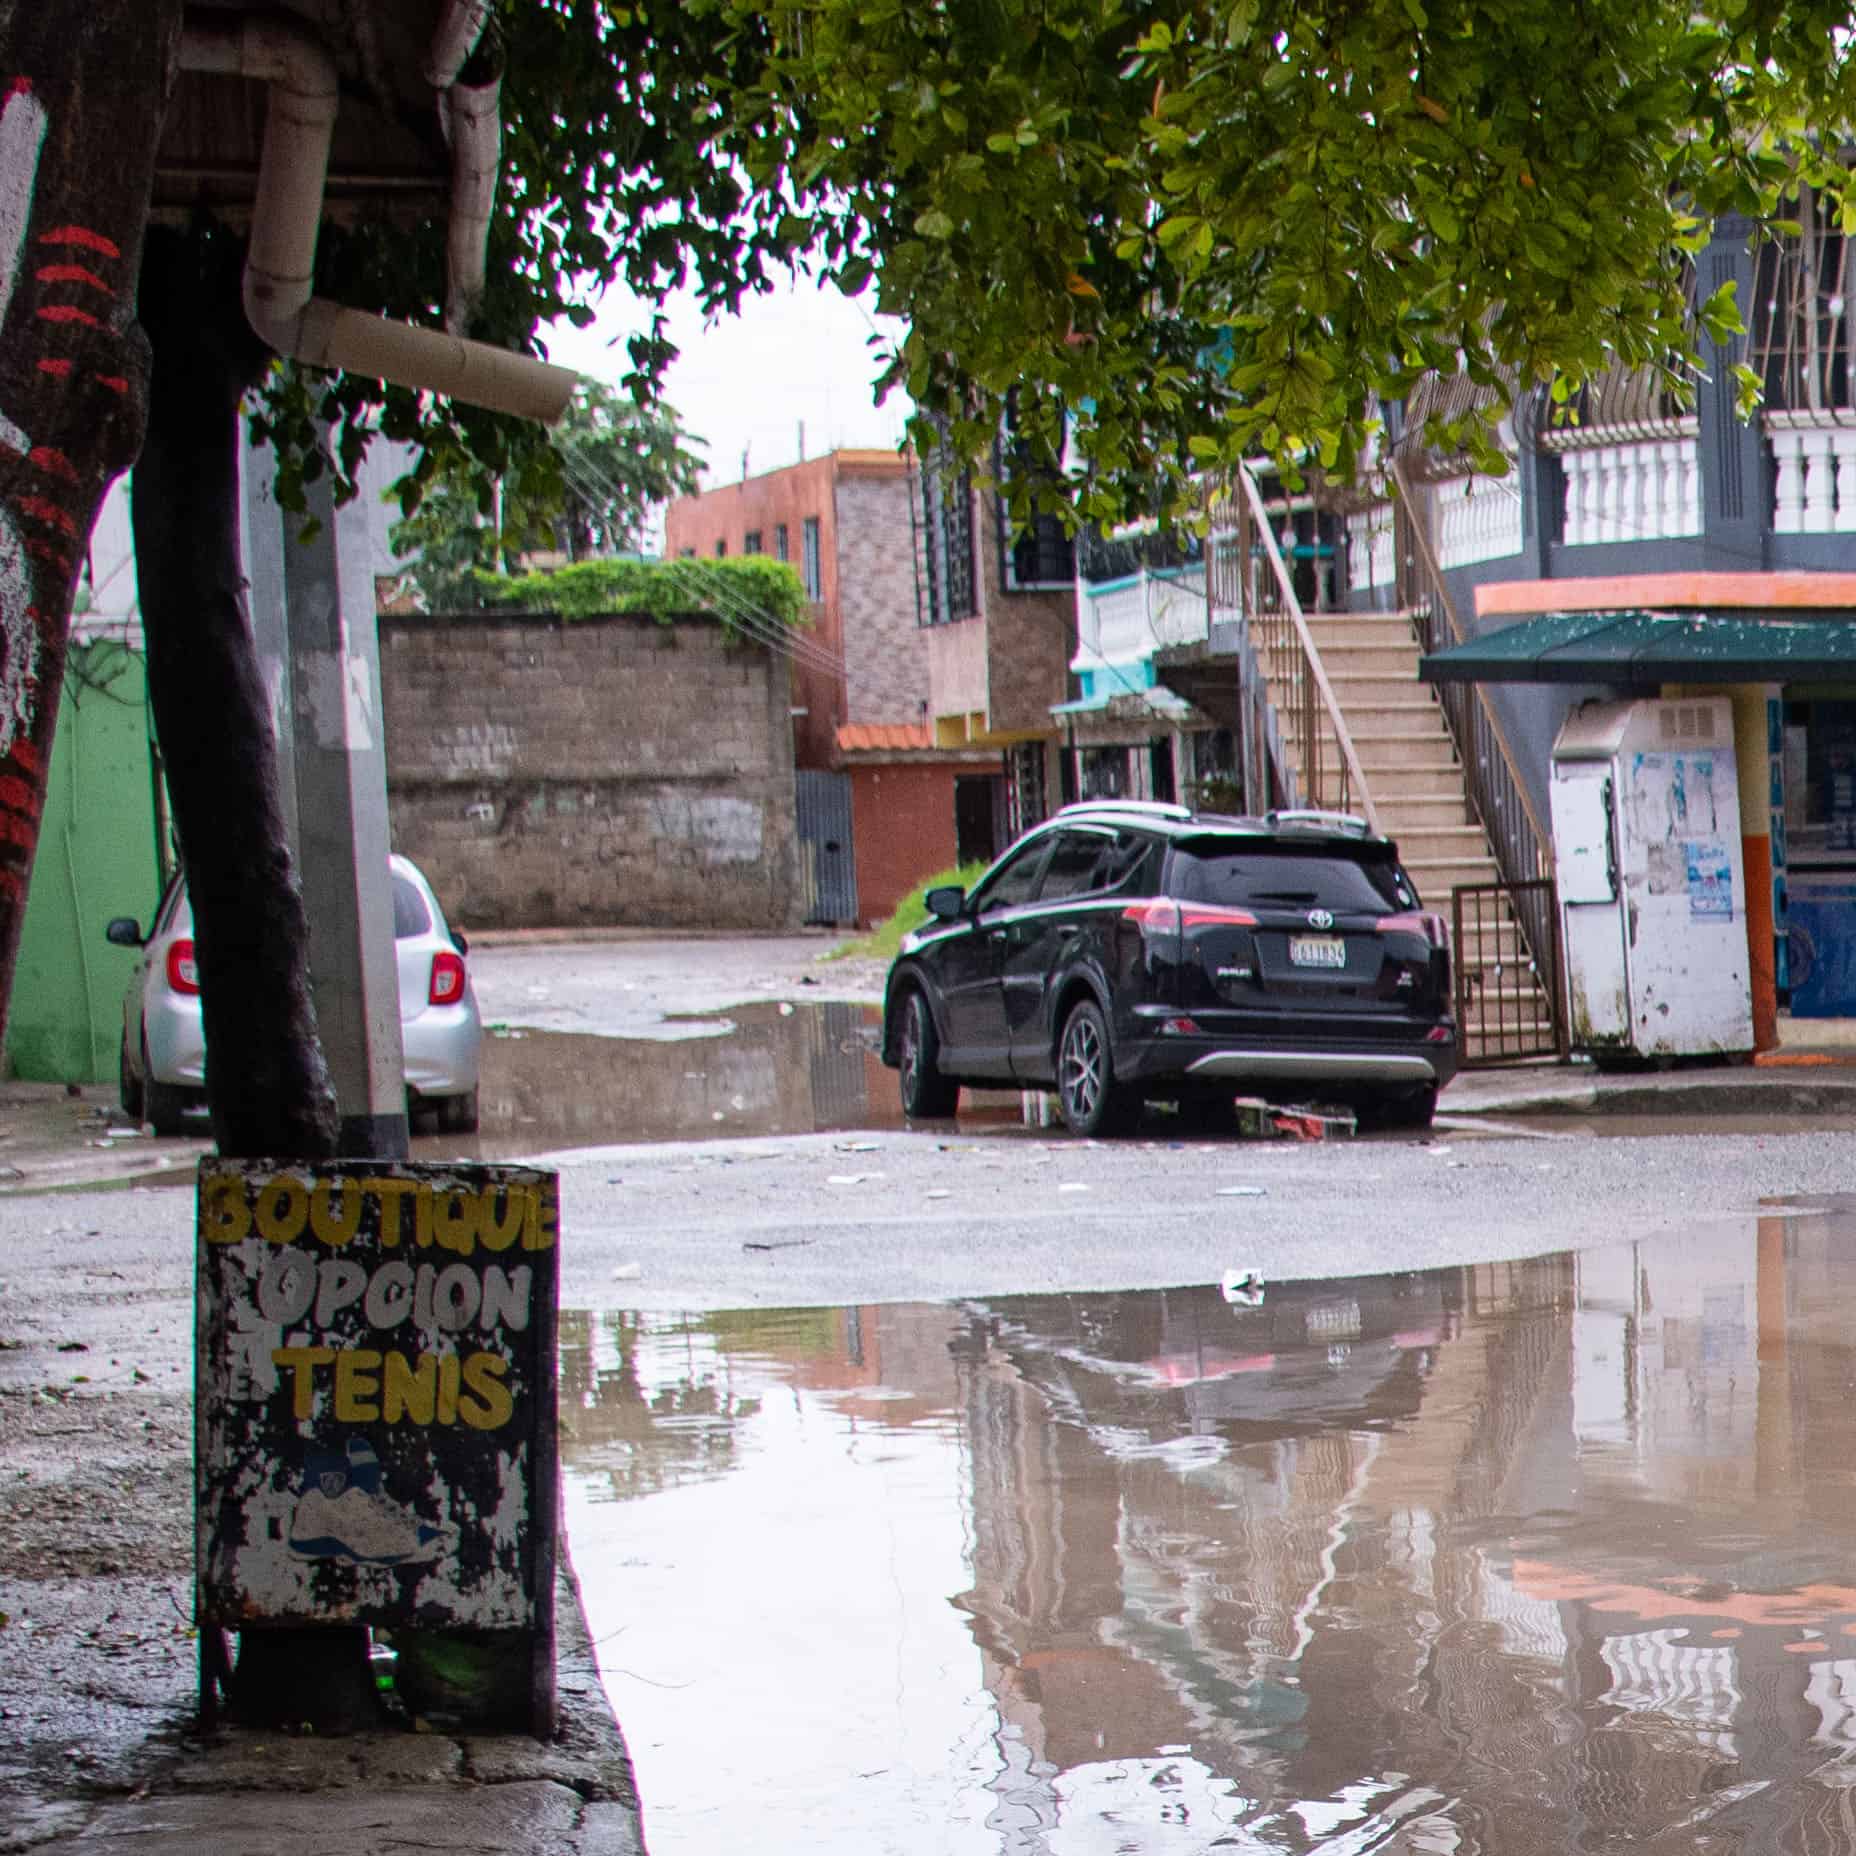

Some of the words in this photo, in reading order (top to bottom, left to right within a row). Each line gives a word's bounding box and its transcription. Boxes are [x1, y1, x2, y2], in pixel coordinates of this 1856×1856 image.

[202, 1175, 557, 1255] BOUTIQUE
[258, 1249, 533, 1331] OPCION
[272, 1348, 514, 1431] TENIS
